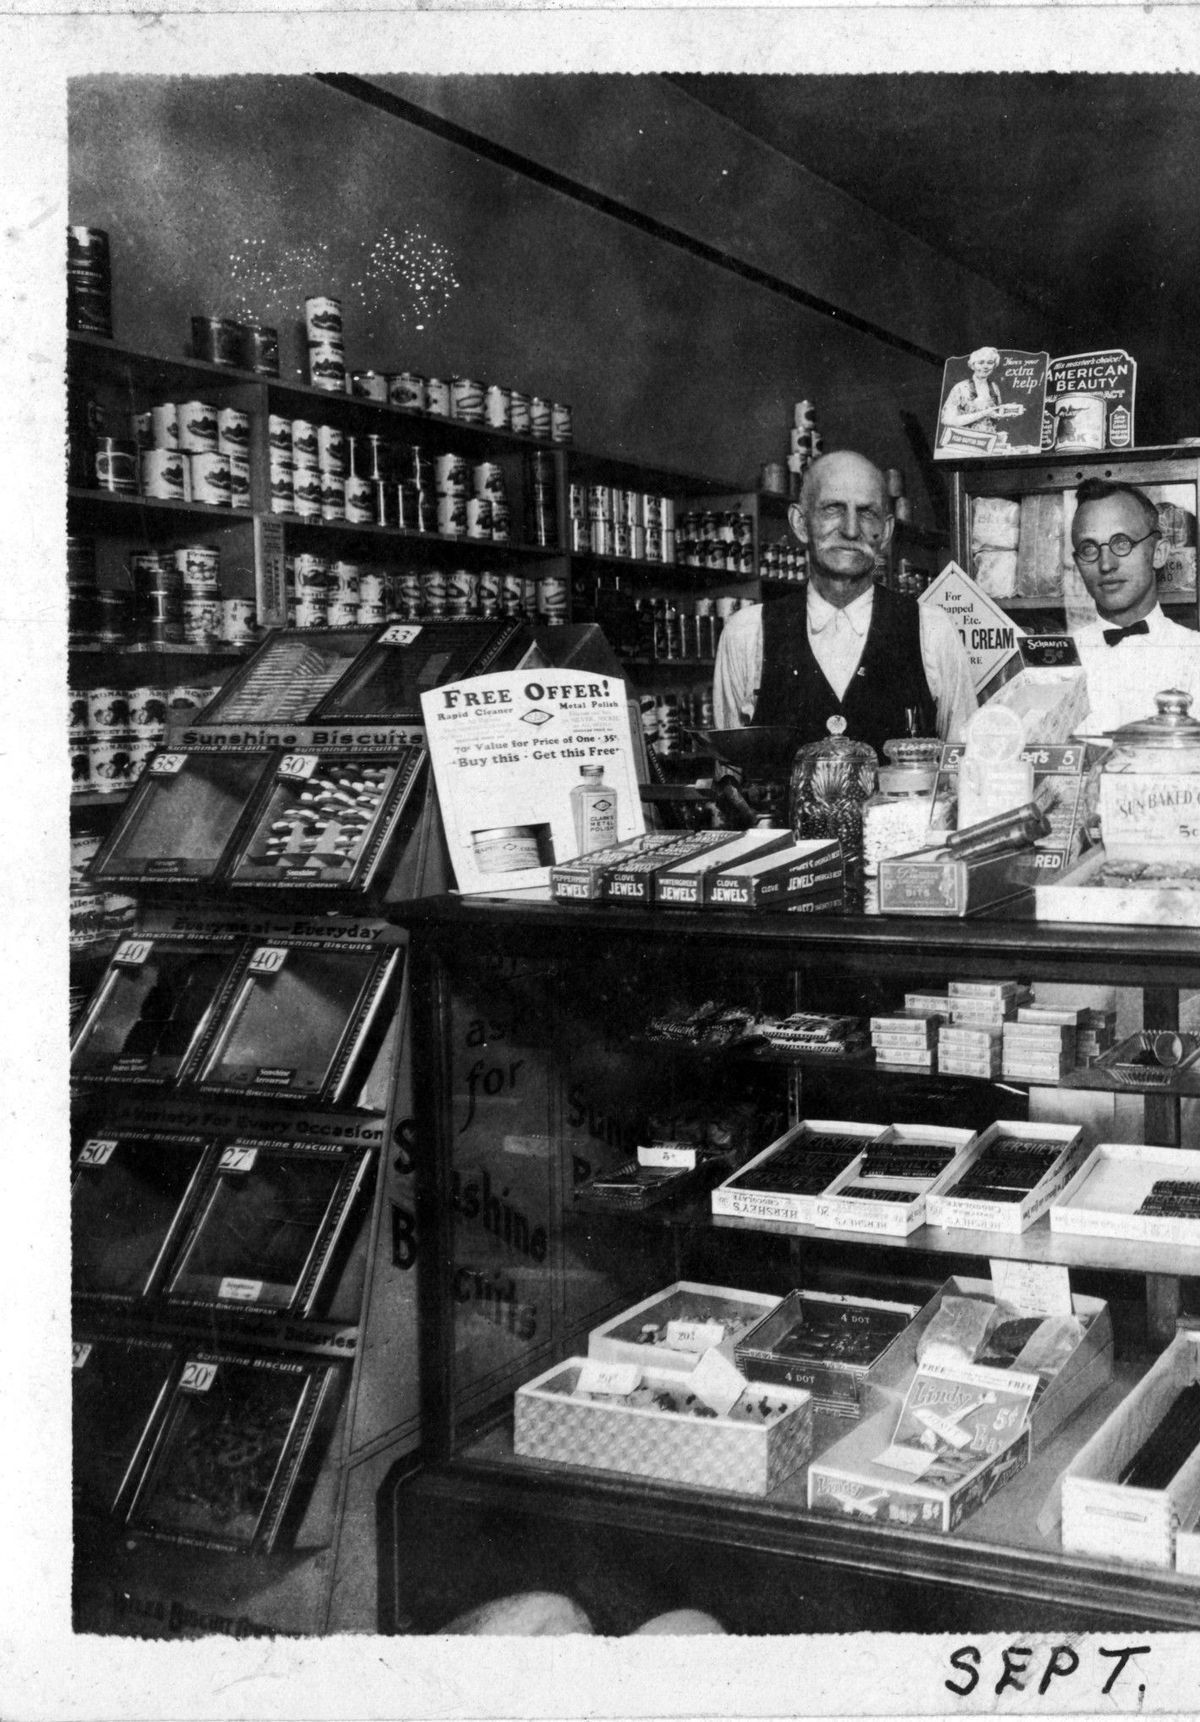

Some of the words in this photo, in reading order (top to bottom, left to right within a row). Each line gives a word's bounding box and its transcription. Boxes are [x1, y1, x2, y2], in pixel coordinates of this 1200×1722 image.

[1005, 368, 1034, 377] extra
[1046, 365, 1128, 381] AMERICAN
[1012, 372, 1045, 394] help!
[1056, 376, 1119, 391] BEAUTY
[945, 591, 962, 601] For
[963, 615, 982, 625] Etc.
[972, 628, 1014, 650] CREAM
[443, 689, 513, 709] FREE
[524, 680, 611, 701] OFFER!
[559, 702, 587, 711] Metal
[591, 701, 619, 709] Polish
[438, 711, 469, 722] Rapid
[475, 707, 514, 718] Cleaner
[182, 730, 297, 745] Sunshine
[312, 730, 423, 745] Biscuits
[475, 742, 509, 752] Value
[512, 739, 529, 749] for
[533, 737, 561, 747] Price
[563, 736, 574, 744] of
[576, 735, 596, 743] One
[459, 756, 488, 768] Buy
[492, 752, 520, 763] this
[533, 750, 557, 761] Get
[561, 749, 586, 759] this
[947, 750, 960, 765] 5
[1063, 750, 1075, 765] 5
[1120, 800, 1146, 819] SUN
[1148, 790, 1194, 809] BAKED
[1035, 855, 1061, 868] RED
[552, 874, 590, 884] PEPPERMINT
[614, 874, 635, 882] CLOVE
[716, 879, 739, 888] CLOVE
[787, 873, 814, 891] JEWELS
[556, 883, 589, 898] JEWELS
[609, 882, 643, 897] JEWELS
[660, 887, 697, 902] JEWELS
[711, 888, 748, 903] JEWELS
[761, 883, 779, 894] CLOVE
[291, 920, 383, 940] Everyday
[266, 938, 322, 949] Sunshine
[325, 941, 372, 951] Biscuits
[252, 950, 283, 969] 40¢
[459, 1057, 527, 1133] for
[296, 1120, 384, 1141] Occasion
[235, 1136, 291, 1147] Sunshine
[294, 1140, 342, 1151] Biscuits
[841, 1313, 848, 1322] 4
[851, 1315, 870, 1324] DOT
[253, 1359, 303, 1373] Biscuits
[785, 1372, 793, 1382] 4
[795, 1373, 816, 1384] DOT
[922, 1363, 946, 1373] FREE
[1008, 1380, 1033, 1391] FREE
[909, 1380, 973, 1411] Lindy
[993, 1407, 1019, 1431] 5¢
[945, 1645, 1150, 1695] SEPT.
